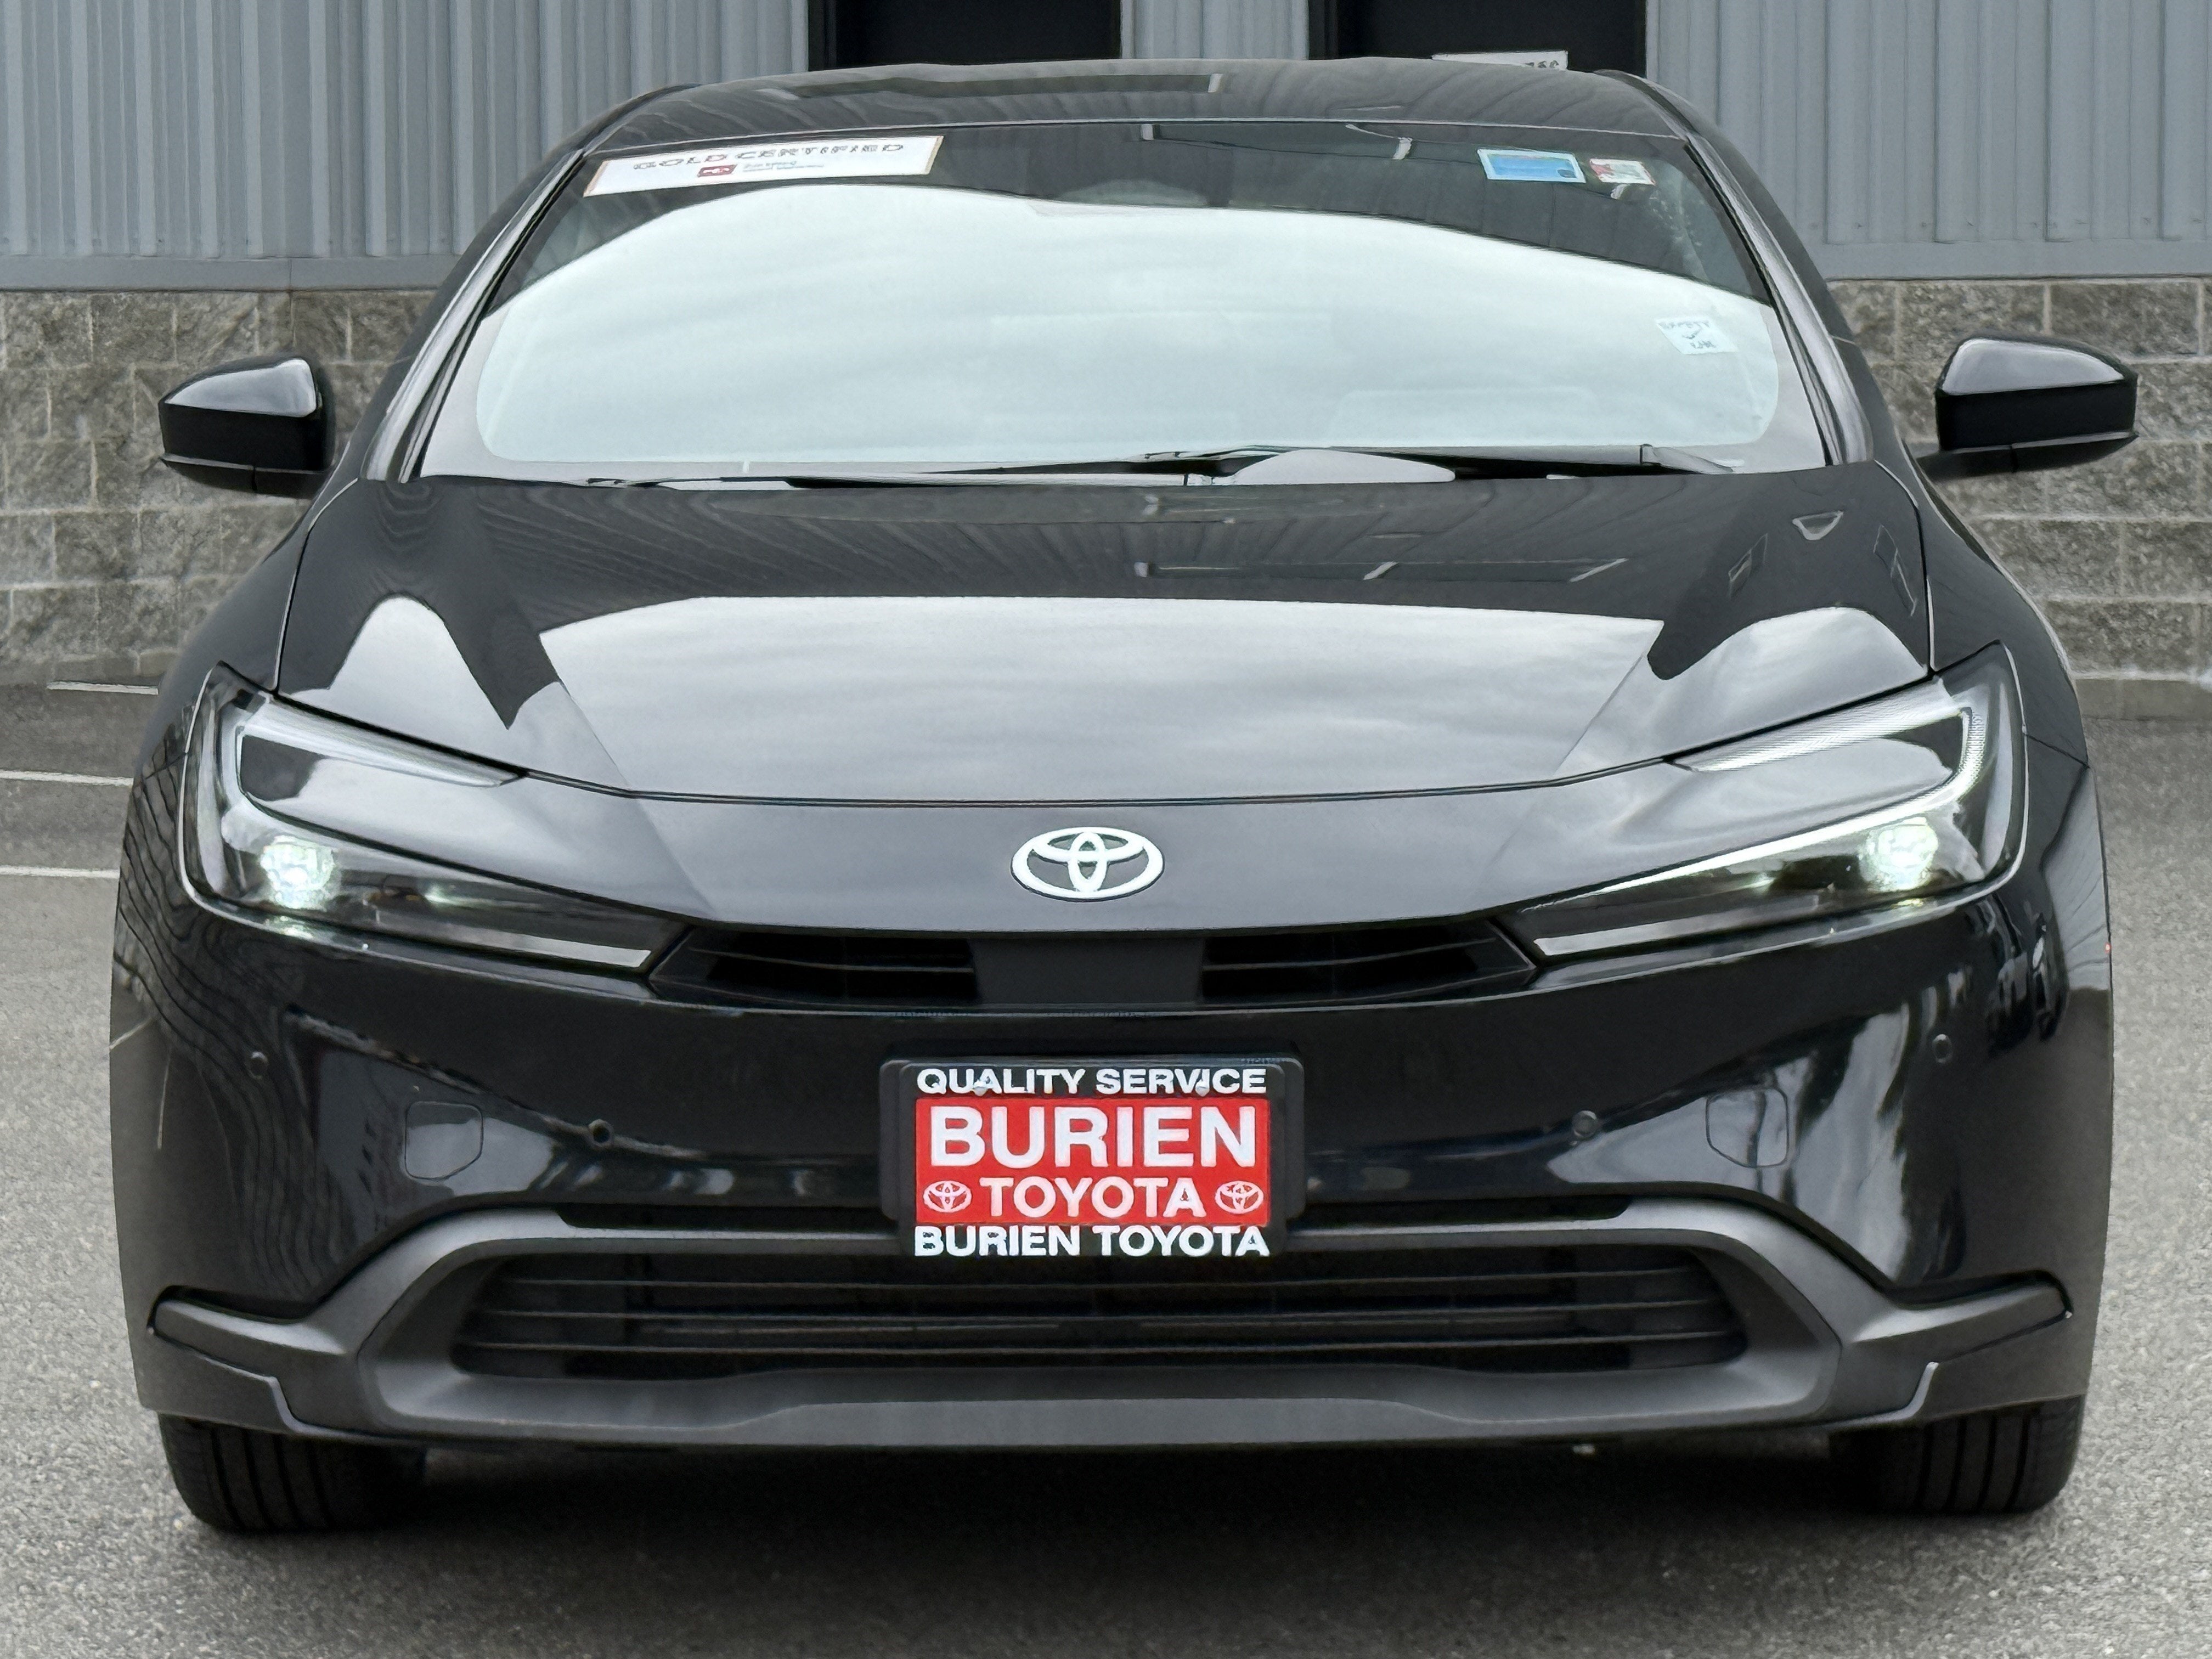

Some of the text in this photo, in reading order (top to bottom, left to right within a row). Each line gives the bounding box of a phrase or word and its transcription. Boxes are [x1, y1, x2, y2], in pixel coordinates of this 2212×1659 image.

[633, 154, 729, 170] GOLD
[735, 144, 904, 159] CERTIFIED
[917, 1068, 1267, 1096] QUALITY SERVICE
[930, 1105, 1256, 1169] BURIEN
[979, 1175, 1207, 1219] TOYOTA
[914, 1225, 1270, 1257] BURIEN TOYOTA
